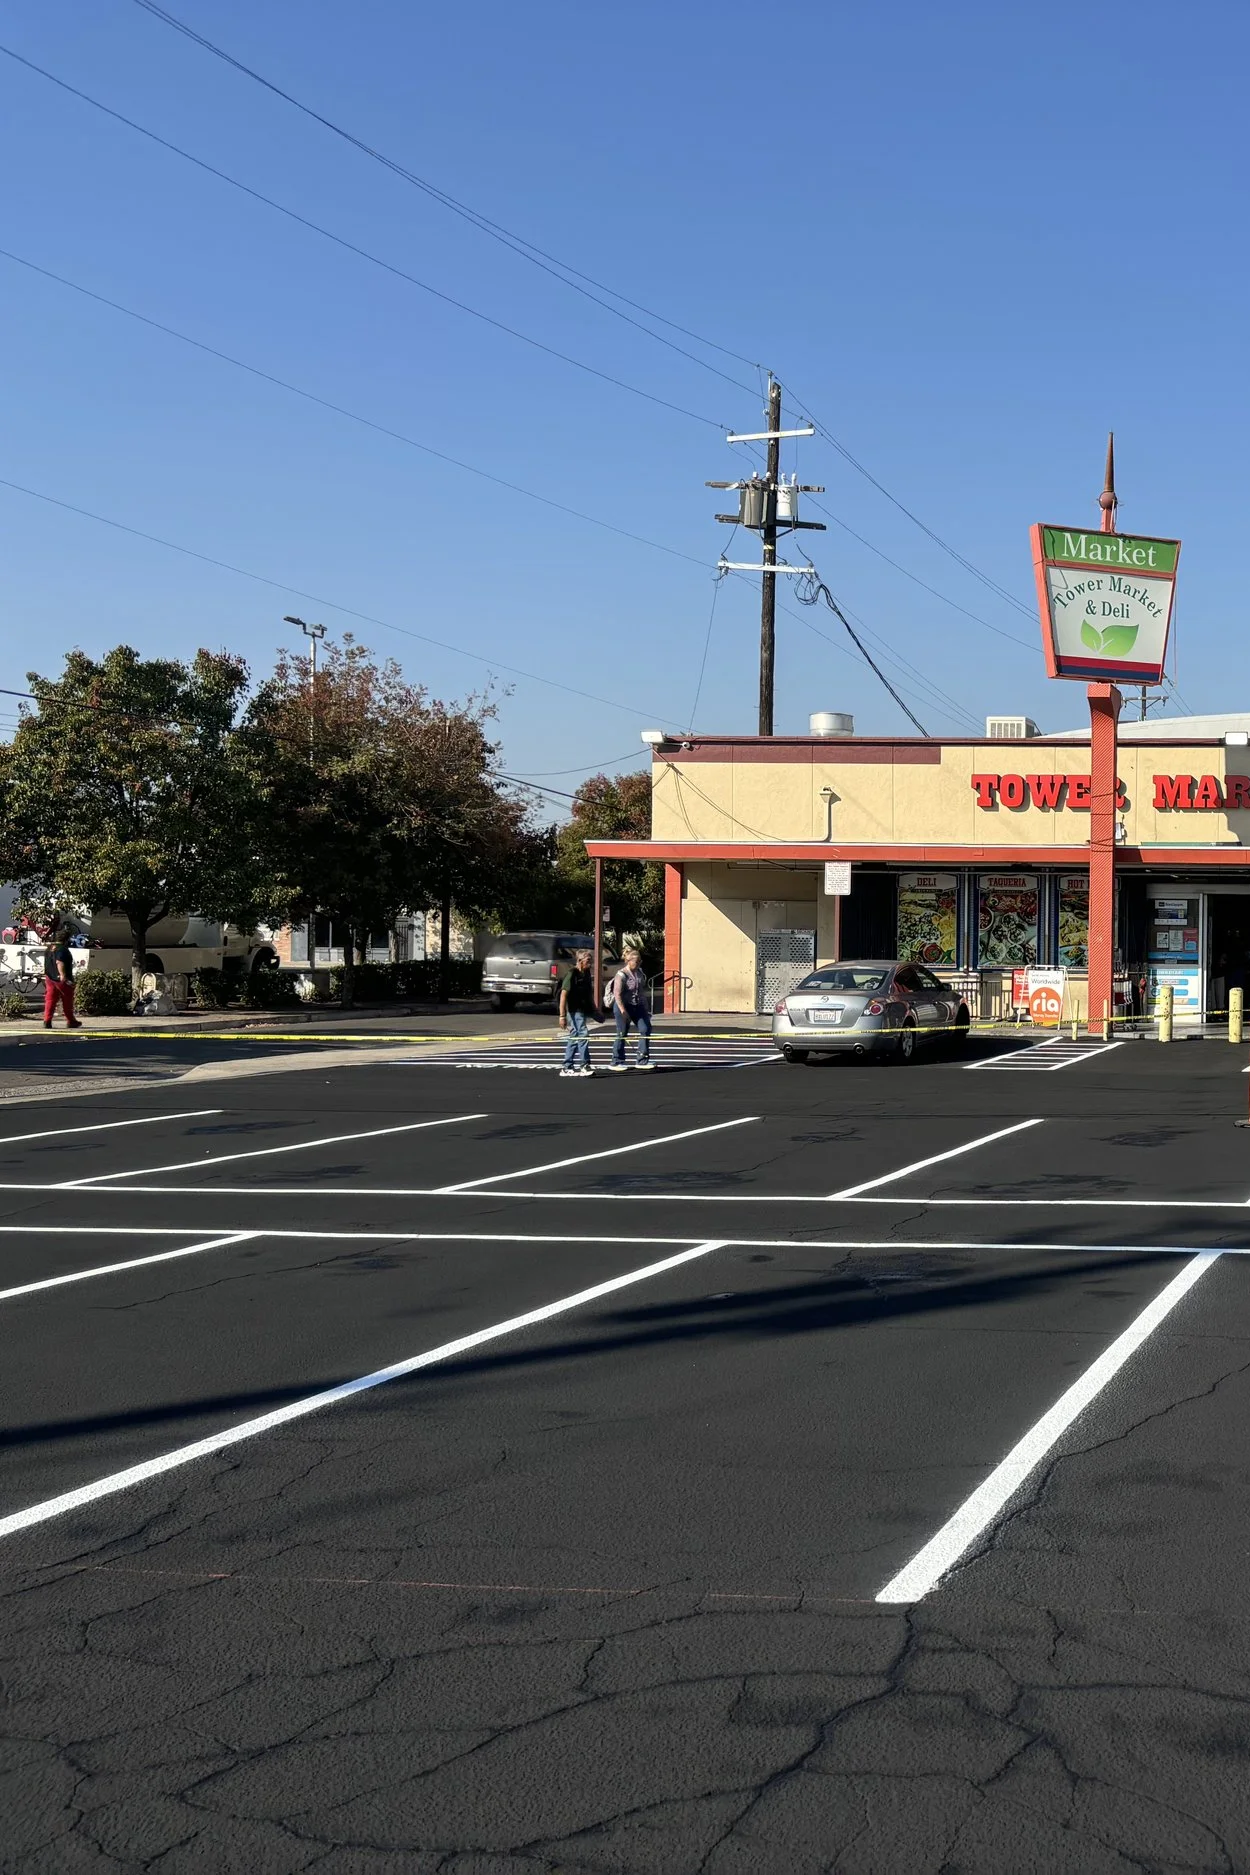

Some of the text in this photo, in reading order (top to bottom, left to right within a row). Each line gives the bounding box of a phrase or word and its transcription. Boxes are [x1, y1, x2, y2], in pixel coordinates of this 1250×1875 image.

[1062, 532, 1157, 567] Market
[1053, 575, 1163, 618] Tower Market
[1085, 600, 1130, 619] & Deli
[917, 877, 937, 887] DELI
[987, 877, 1027, 887] TAQUERIA
[1067, 879, 1085, 888] HOT
[1033, 991, 1059, 1012] ria
